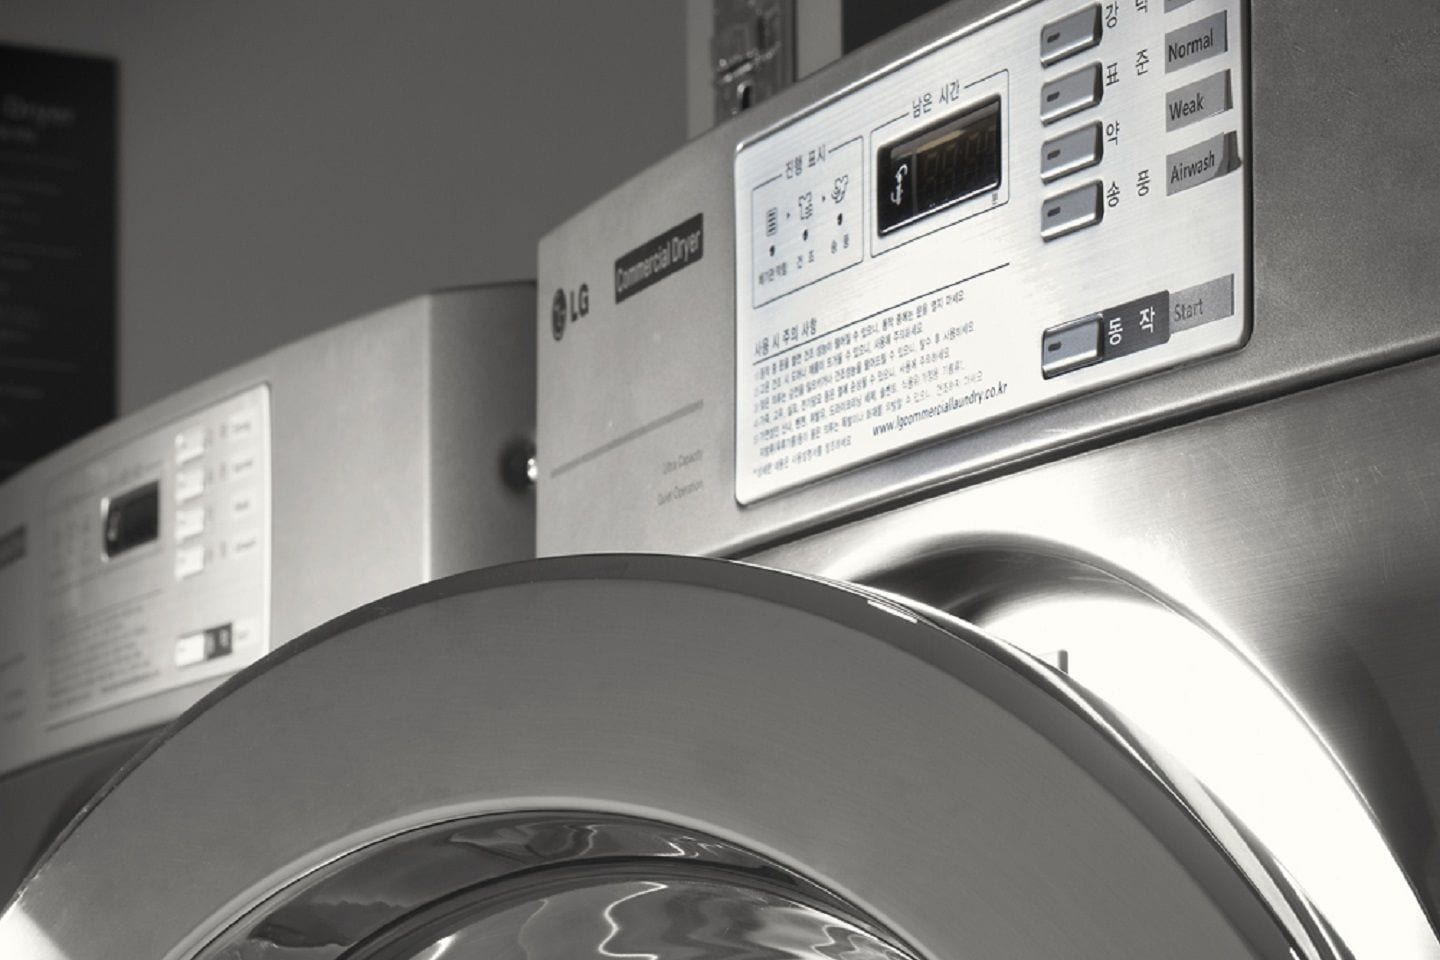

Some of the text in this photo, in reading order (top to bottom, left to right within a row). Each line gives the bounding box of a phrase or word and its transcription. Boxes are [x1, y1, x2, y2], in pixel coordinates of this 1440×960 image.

[1168, 28, 1214, 62] Normal
[913, 79, 960, 119] 남은 시간
[1169, 93, 1205, 121] Weak
[1106, 120, 1120, 145] 약
[785, 144, 826, 180] 진행 표시
[1170, 150, 1215, 184] Airwash
[616, 230, 701, 293] Commercial Dryer
[569, 282, 590, 322] LG
[1174, 298, 1204, 322] Start
[872, 380, 1008, 437] www.lgcommerciallaundry.co.kr
